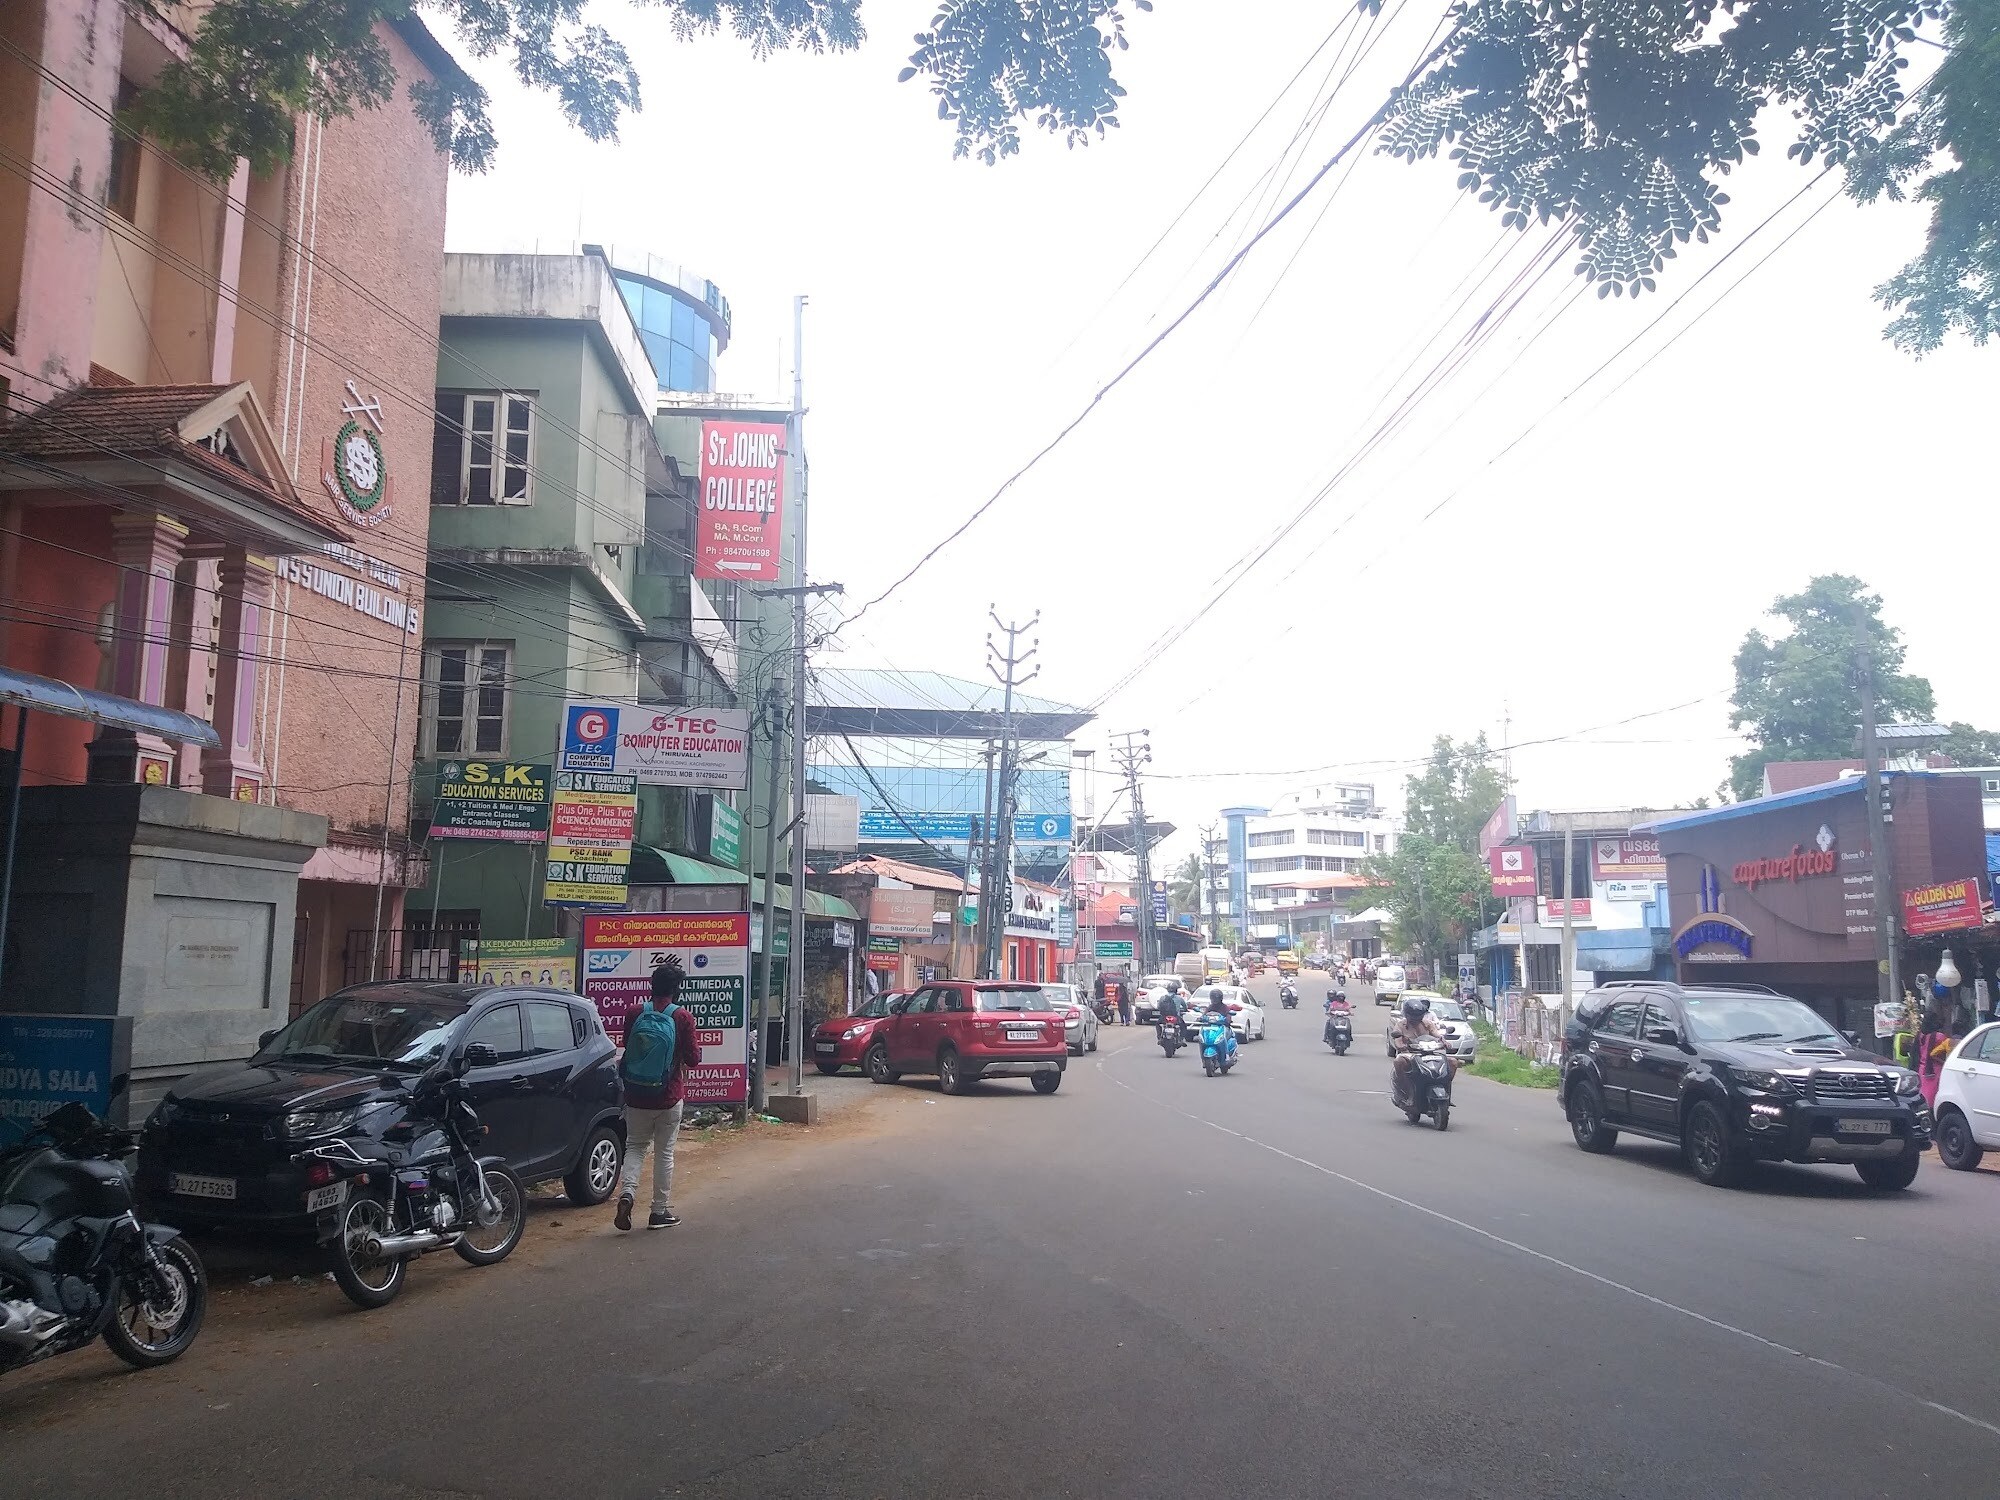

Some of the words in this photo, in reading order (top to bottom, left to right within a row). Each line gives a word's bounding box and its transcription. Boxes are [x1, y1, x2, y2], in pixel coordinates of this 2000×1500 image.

[324, 470, 341, 499] NAIR
[337, 496, 367, 527] SERVICE
[368, 504, 393, 527] SOCIETY
[705, 476, 777, 514] COLLEGE
[714, 522, 731, 533] BA,
[732, 523, 762, 533] B.Com
[713, 532, 731, 542] MA,
[313, 566, 354, 607] UNION
[579, 713, 606, 740] G
[651, 716, 718, 735] G-TEC
[577, 743, 603, 753] TEC
[623, 733, 681, 750] COMPUTER
[682, 736, 742, 754] EDUCATION
[660, 751, 703, 759] THIRUVALLA
[567, 760, 611, 768] EDUCATION
[464, 763, 544, 786] S.K.
[593, 773, 635, 785] EDUCATION
[441, 783, 496, 800] EDUCATION
[498, 786, 544, 802] SERVICES
[594, 782, 632, 793] SERVICES
[468, 801, 491, 809] Tuition
[499, 803, 514, 811] Med
[557, 804, 576, 815] Plus
[577, 805, 596, 816] One,
[597, 806, 615, 817] Plus
[617, 807, 633, 818] Two
[462, 810, 493, 818] Entrance
[493, 811, 520, 819] Classes
[451, 817, 466, 825] PSC
[467, 818, 501, 828] Coaching
[502, 820, 531, 828] Classes
[566, 837, 600, 847] Repeaters
[601, 839, 621, 848] Batch
[569, 848, 586, 856] PSC
[591, 849, 614, 857] BANK
[573, 855, 609, 863] Coaching
[585, 863, 627, 875] EDUCATION
[1732, 843, 1835, 892] capturefotos
[587, 873, 623, 884] SERVICES
[1609, 882, 1627, 891] Ria
[1914, 887, 1947, 906] GOLDEN
[1946, 883, 1966, 900] SUN
[890, 905, 915, 914] (SJC)
[598, 919, 621, 931] PSC
[532, 938, 566, 947] SERVICES
[588, 954, 623, 969] SAP
[649, 952, 684, 968] Tally
[677, 992, 733, 1002] ANIMATION
[709, 1004, 732, 1014] CAD
[707, 1016, 738, 1026] REVIT
[47, 1069, 98, 1093] SALA
[1873, 1122, 1889, 1132] 777
